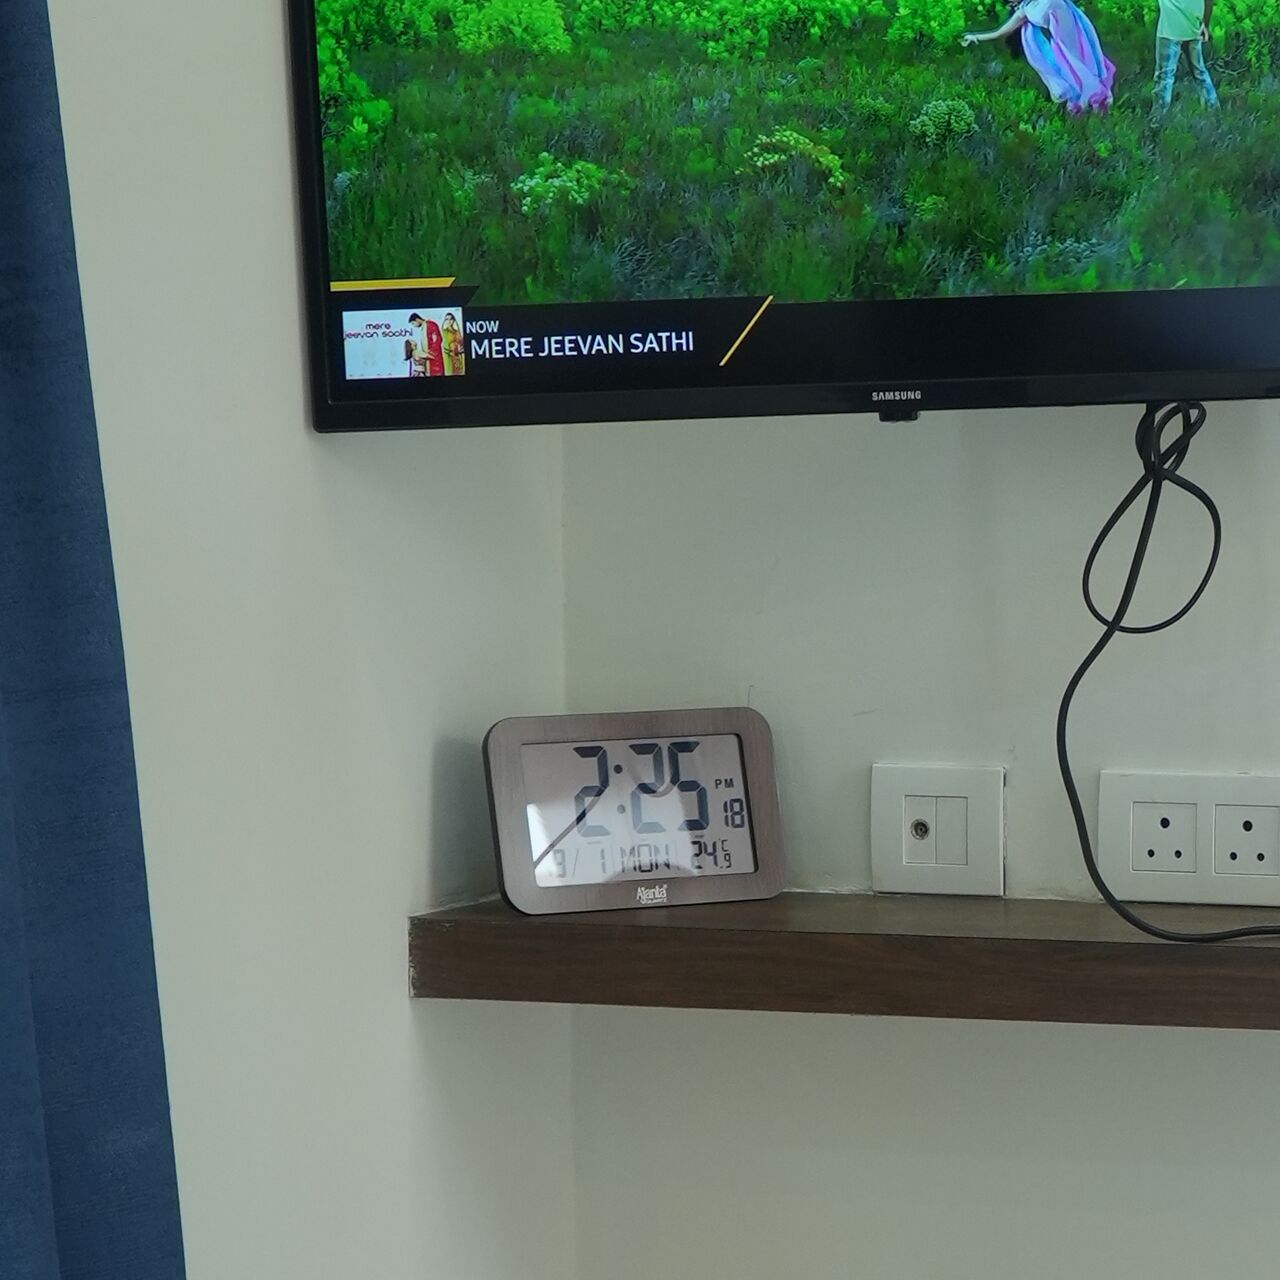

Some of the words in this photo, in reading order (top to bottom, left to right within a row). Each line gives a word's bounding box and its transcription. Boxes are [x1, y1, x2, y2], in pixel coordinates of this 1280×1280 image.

[466, 320, 499, 334] NOW
[471, 336, 533, 359] MERE
[538, 334, 624, 357] JEEVAN
[629, 331, 694, 353] SATHI
[871, 390, 922, 401] SAMSUNG
[573, 741, 709, 838] 2:25
[715, 778, 734, 789] PM
[723, 798, 745, 829] 18
